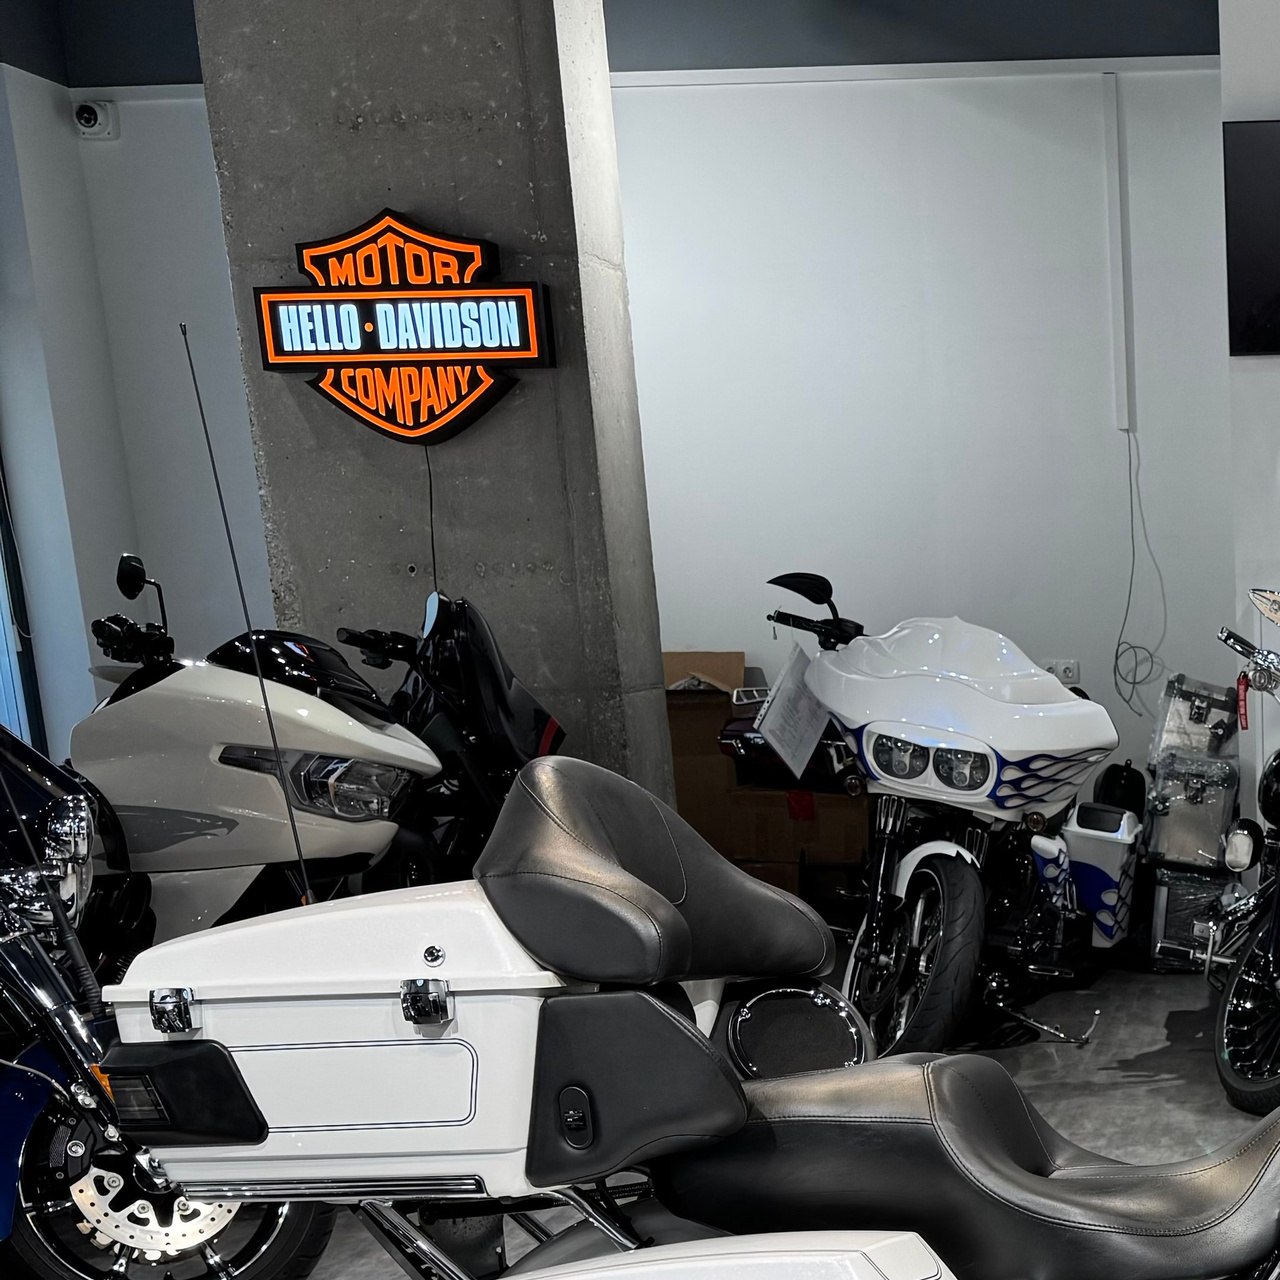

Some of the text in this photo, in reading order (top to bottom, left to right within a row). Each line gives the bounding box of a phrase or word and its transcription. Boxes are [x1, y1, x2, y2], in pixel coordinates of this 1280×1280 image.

[328, 232, 460, 287] MOTOR
[279, 301, 520, 351] HELLO DAVIDSON
[340, 365, 471, 426] COMPANY
